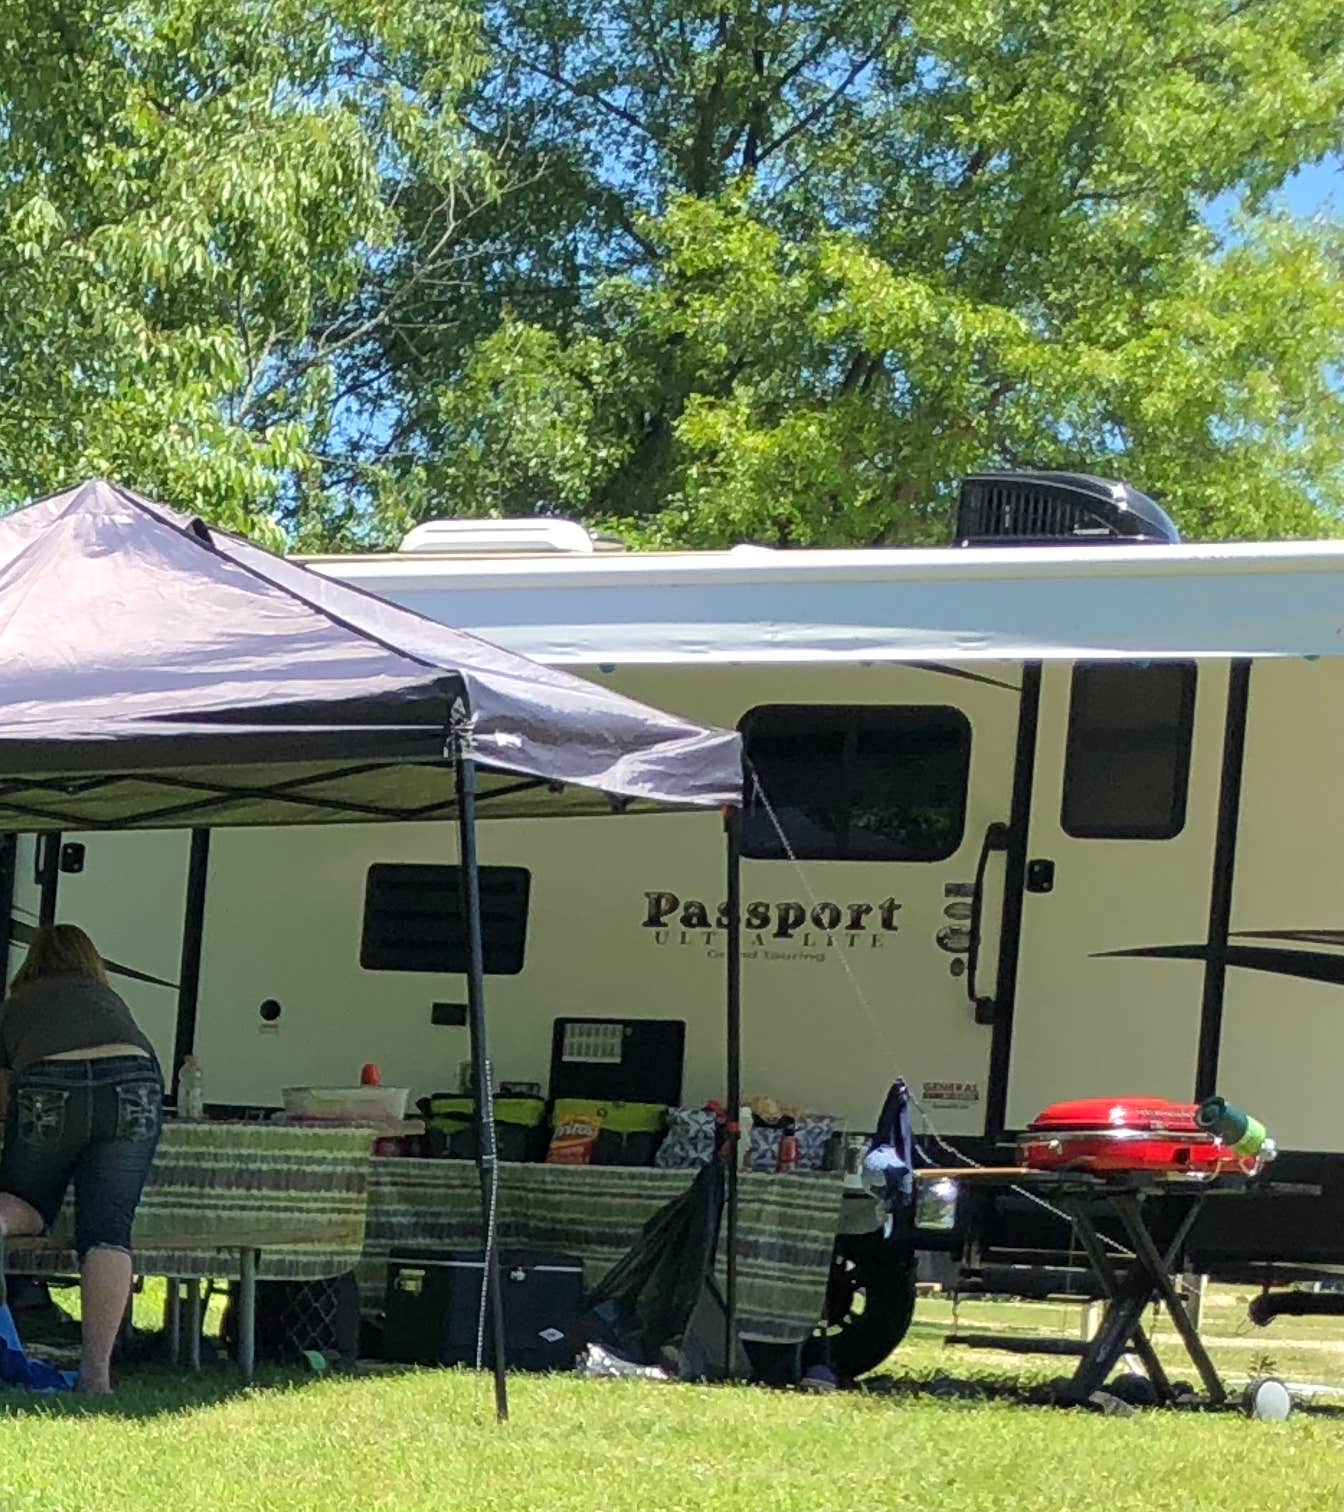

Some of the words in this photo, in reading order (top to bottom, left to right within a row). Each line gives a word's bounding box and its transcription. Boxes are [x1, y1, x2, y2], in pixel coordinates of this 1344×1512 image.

[641, 891, 902, 938] Passport
[654, 930, 765, 946] ULTA
[803, 932, 885, 948] LITE
